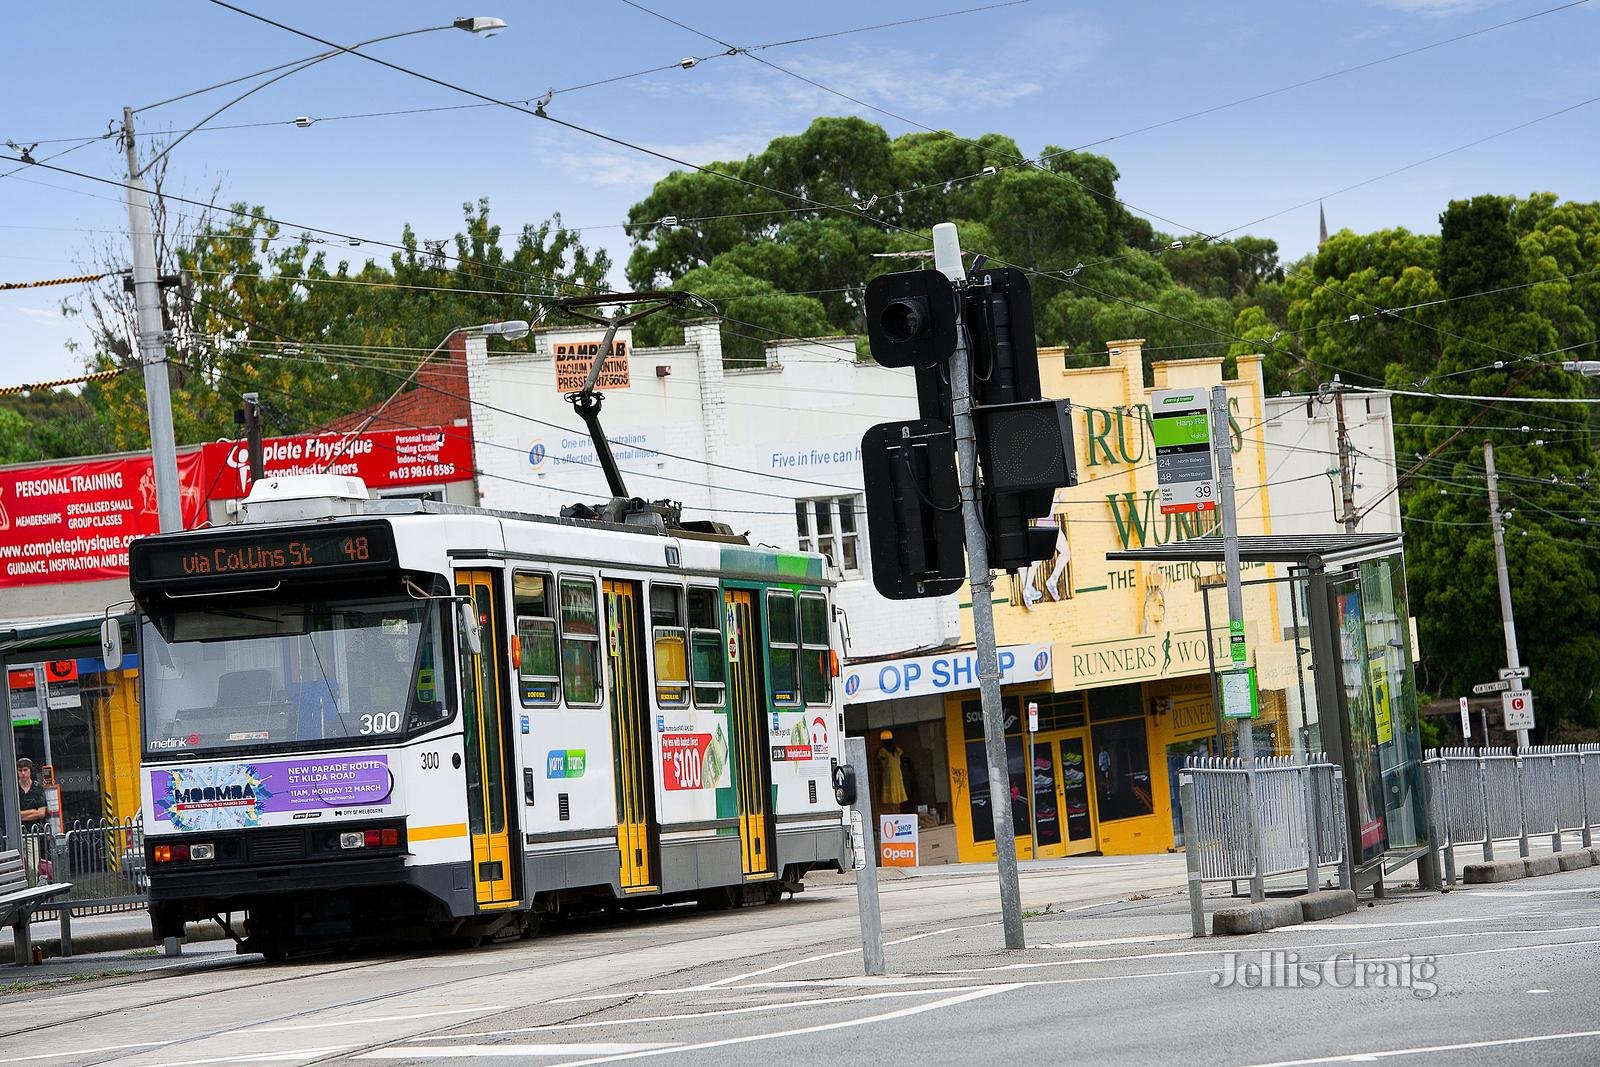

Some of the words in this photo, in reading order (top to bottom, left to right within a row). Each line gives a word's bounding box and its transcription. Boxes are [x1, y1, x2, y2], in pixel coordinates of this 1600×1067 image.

[557, 342, 626, 361] BAMPAB
[557, 363, 588, 376] VACUUM
[395, 434, 421, 444] Personal
[562, 439, 578, 449] One
[579, 439, 586, 447] in
[772, 453, 796, 468] Five
[798, 451, 808, 466] in
[811, 449, 831, 465] five
[833, 451, 852, 463] can
[1160, 459, 1171, 468] 24
[389, 470, 399, 479] Ph
[398, 467, 410, 479] 03
[410, 465, 433, 478] 9816
[1160, 473, 1172, 481] 48
[15, 477, 70, 498] PERSONAL
[70, 472, 122, 493] TRAINING
[1195, 486, 1212, 498] 39
[66, 501, 111, 516] SPECIALISED
[110, 499, 134, 511] SMALL
[15, 512, 62, 528] MEMBERSHIPS
[68, 517, 92, 530] GROUP
[92, 514, 122, 527] CLASSES
[182, 553, 211, 574] via
[214, 546, 285, 573] Collins
[289, 542, 313, 565] St
[344, 536, 369, 561] 48
[7, 561, 48, 576] GUIDANCE,
[49, 557, 99, 572] INSPIRATION
[100, 554, 118, 568] AND
[1107, 569, 1137, 590] THE
[1072, 645, 1157, 678] RUNNERS
[1177, 637, 1232, 664] WOL
[879, 663, 922, 694] OP
[932, 652, 1015, 688] SHP
[1513, 699, 1522, 710] C
[360, 711, 400, 735] 300
[150, 737, 188, 750] metlink
[288, 766, 309, 775] NEW
[311, 763, 348, 774] PARADE
[349, 761, 380, 771] ROUTE
[420, 751, 440, 770] 300
[549, 757, 564, 776] yarra
[568, 755, 584, 770] trams
[673, 748, 700, 788] $100
[288, 775, 300, 784] ST
[301, 773, 329, 783] KILDA
[330, 771, 356, 781] ROAD
[290, 788, 311, 798] 11AM,
[311, 786, 343, 797] MONDAY
[344, 785, 353, 793] 12
[354, 783, 381, 793] MARCH
[883, 847, 914, 862] Open
